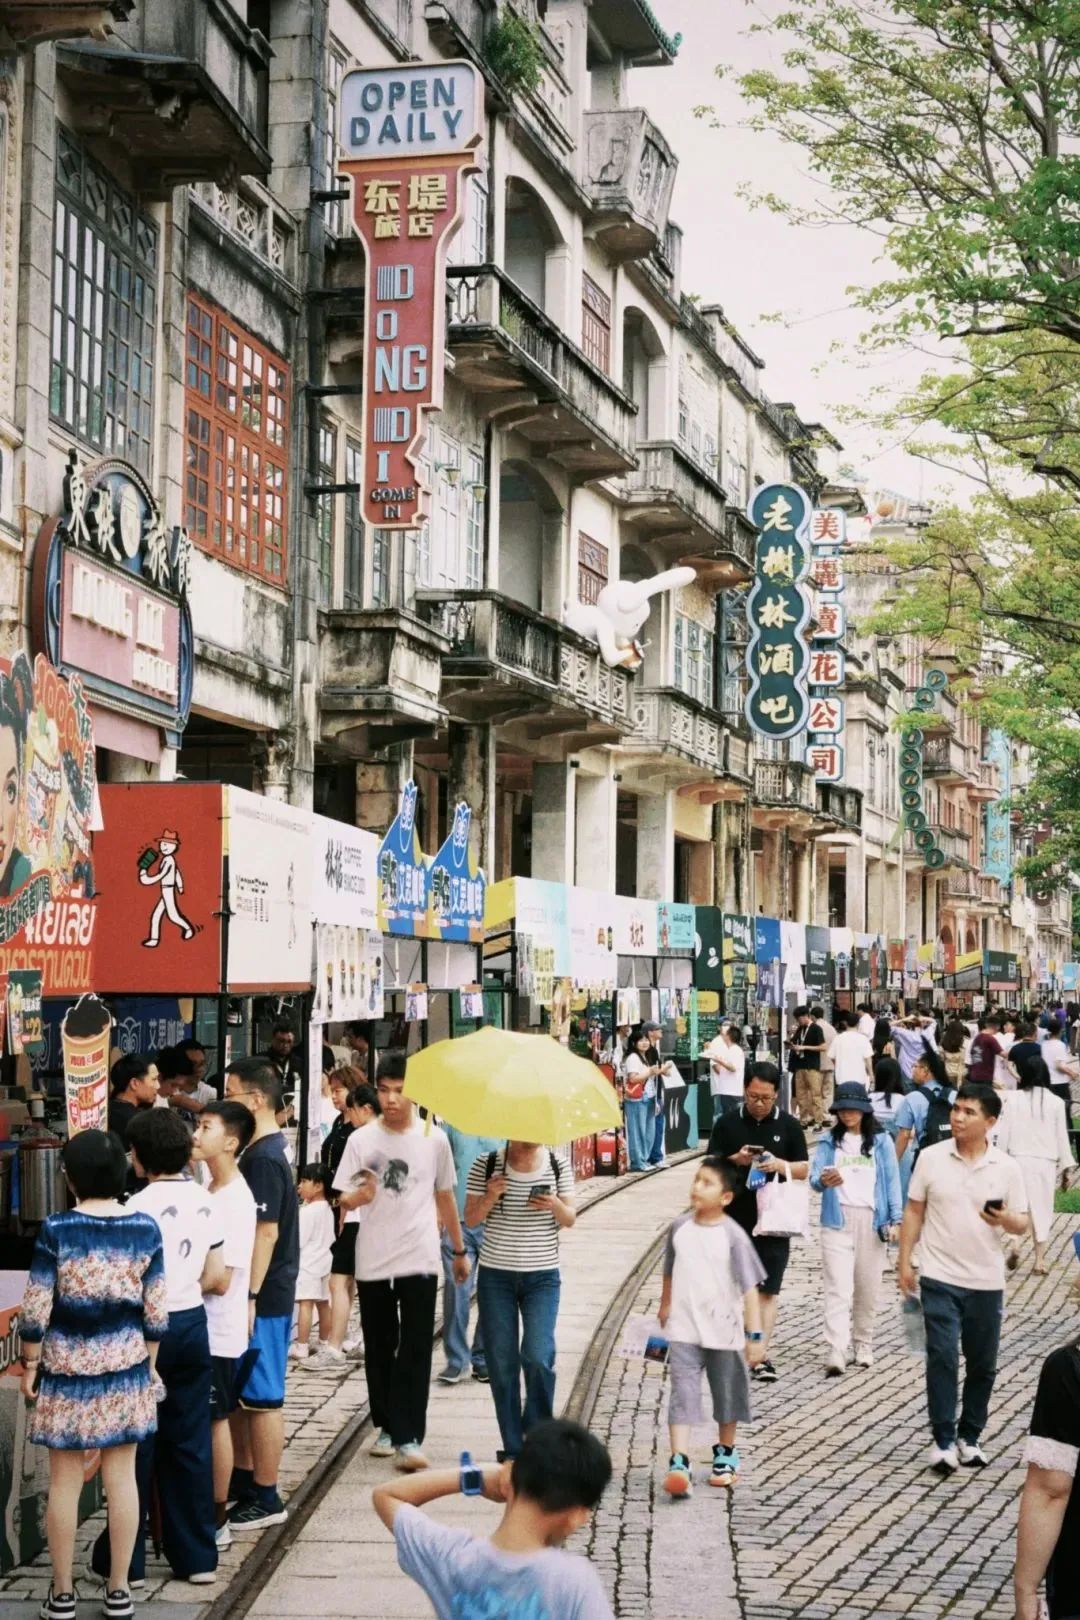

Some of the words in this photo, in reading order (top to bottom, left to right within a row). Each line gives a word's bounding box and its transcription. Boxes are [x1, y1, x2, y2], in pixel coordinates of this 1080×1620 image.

[361, 77, 455, 112] OPEN
[350, 109, 463, 146] DAILY
[363, 174, 448, 213] 东堤
[374, 213, 435, 239] 旅店
[370, 486, 416, 502] COME
[383, 504, 401, 519] IN
[758, 496, 797, 726] 老樹林酒吧
